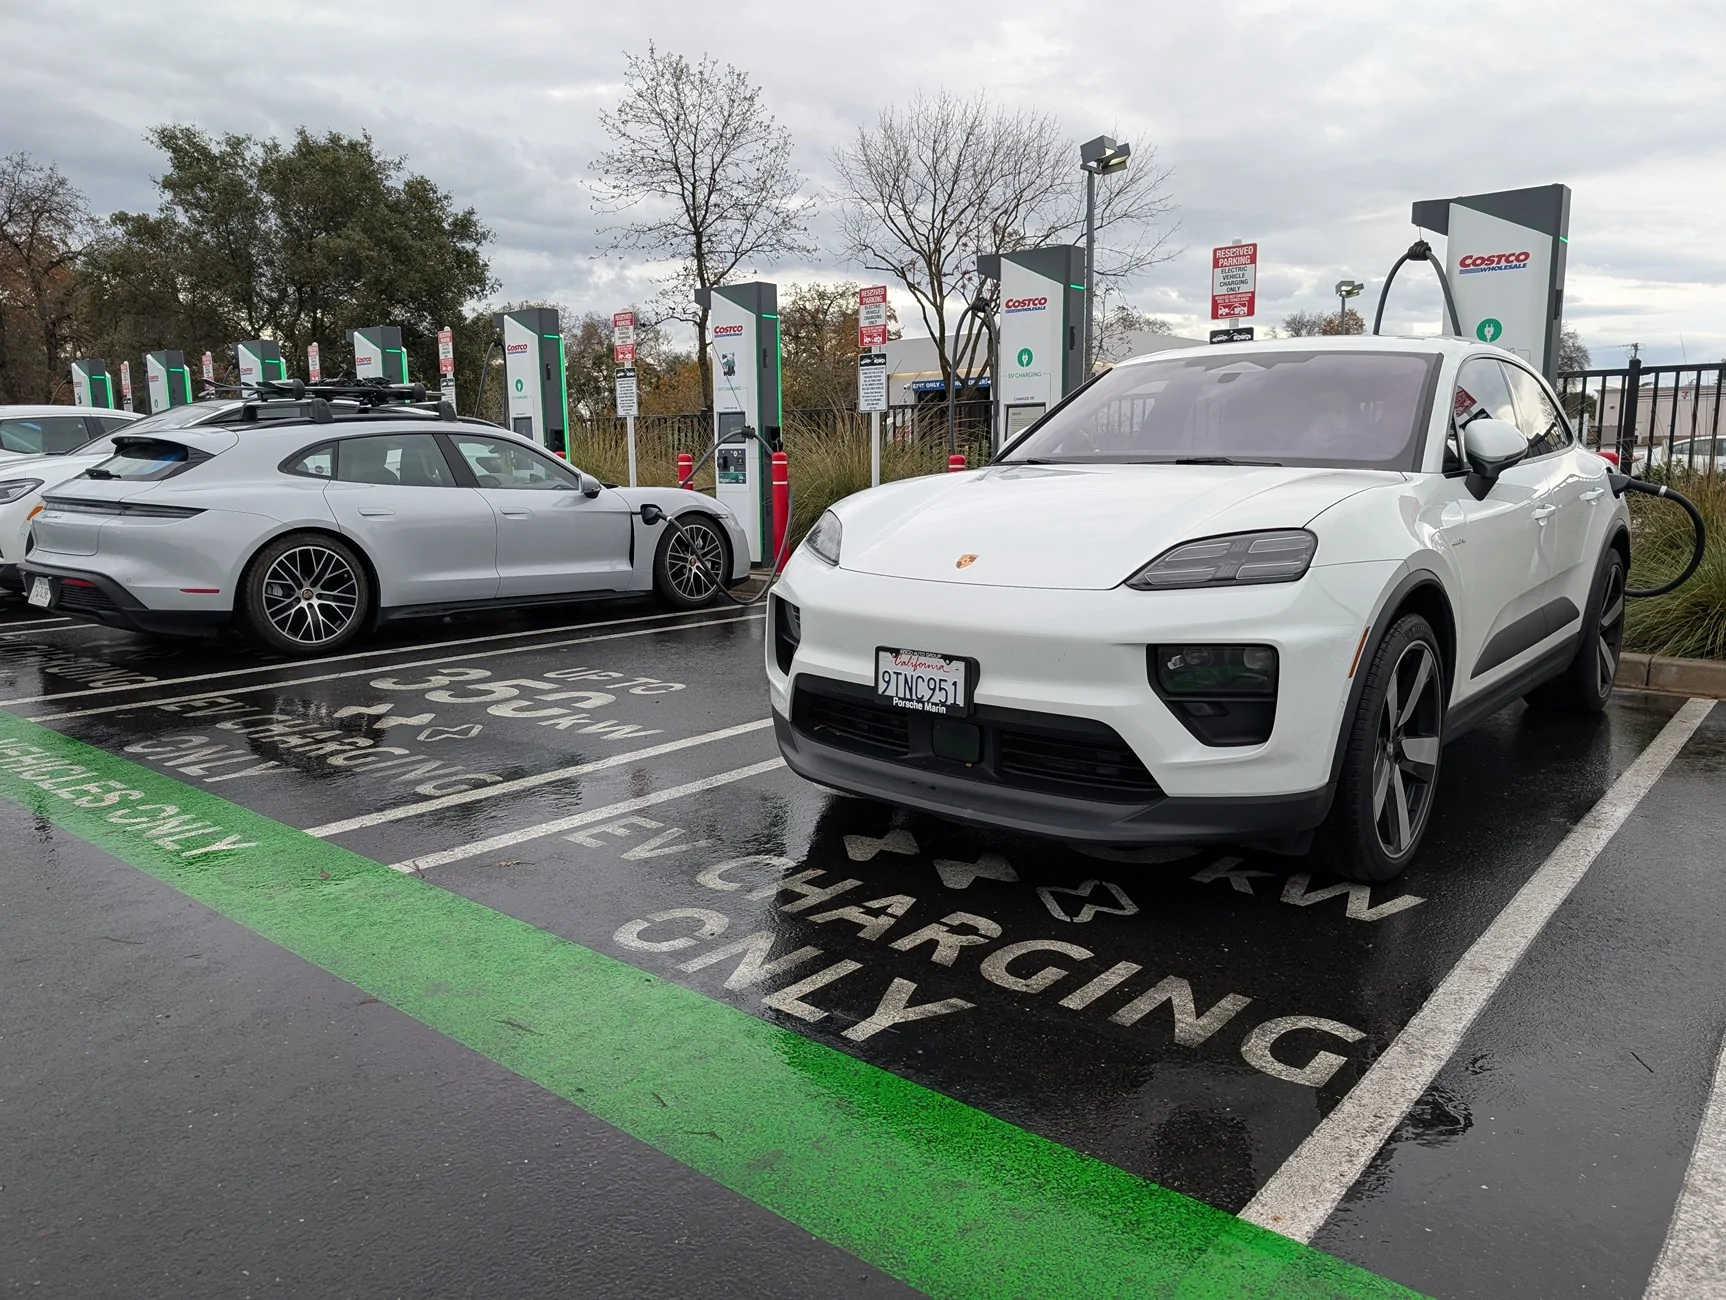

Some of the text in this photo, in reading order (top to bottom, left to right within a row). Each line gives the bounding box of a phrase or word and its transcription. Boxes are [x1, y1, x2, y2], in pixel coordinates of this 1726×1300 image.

[1216, 246, 1253, 258] RESERVED
[1459, 251, 1530, 268] COSTCO
[1219, 256, 1250, 267] PARKING
[1221, 266, 1247, 274] ELECTRIC
[1480, 263, 1528, 272] WHOLESALE
[1219, 279, 1248, 287] CHARGING
[1005, 297, 1047, 309] COSTCO
[714, 325, 743, 334] COSTCO
[507, 344, 527, 352] COSTCO
[894, 653, 950, 673] California
[543, 667, 686, 695] UP TO
[881, 670, 960, 706] 9TNC951
[369, 667, 617, 718] 350
[893, 697, 946, 714] Porsche Marin
[123, 735, 302, 783] ONLY
[106, 804, 258, 858] ONLY
[565, 817, 727, 861] EV
[612, 908, 977, 1042] ONLY
[695, 855, 1367, 1088] CHARGING
